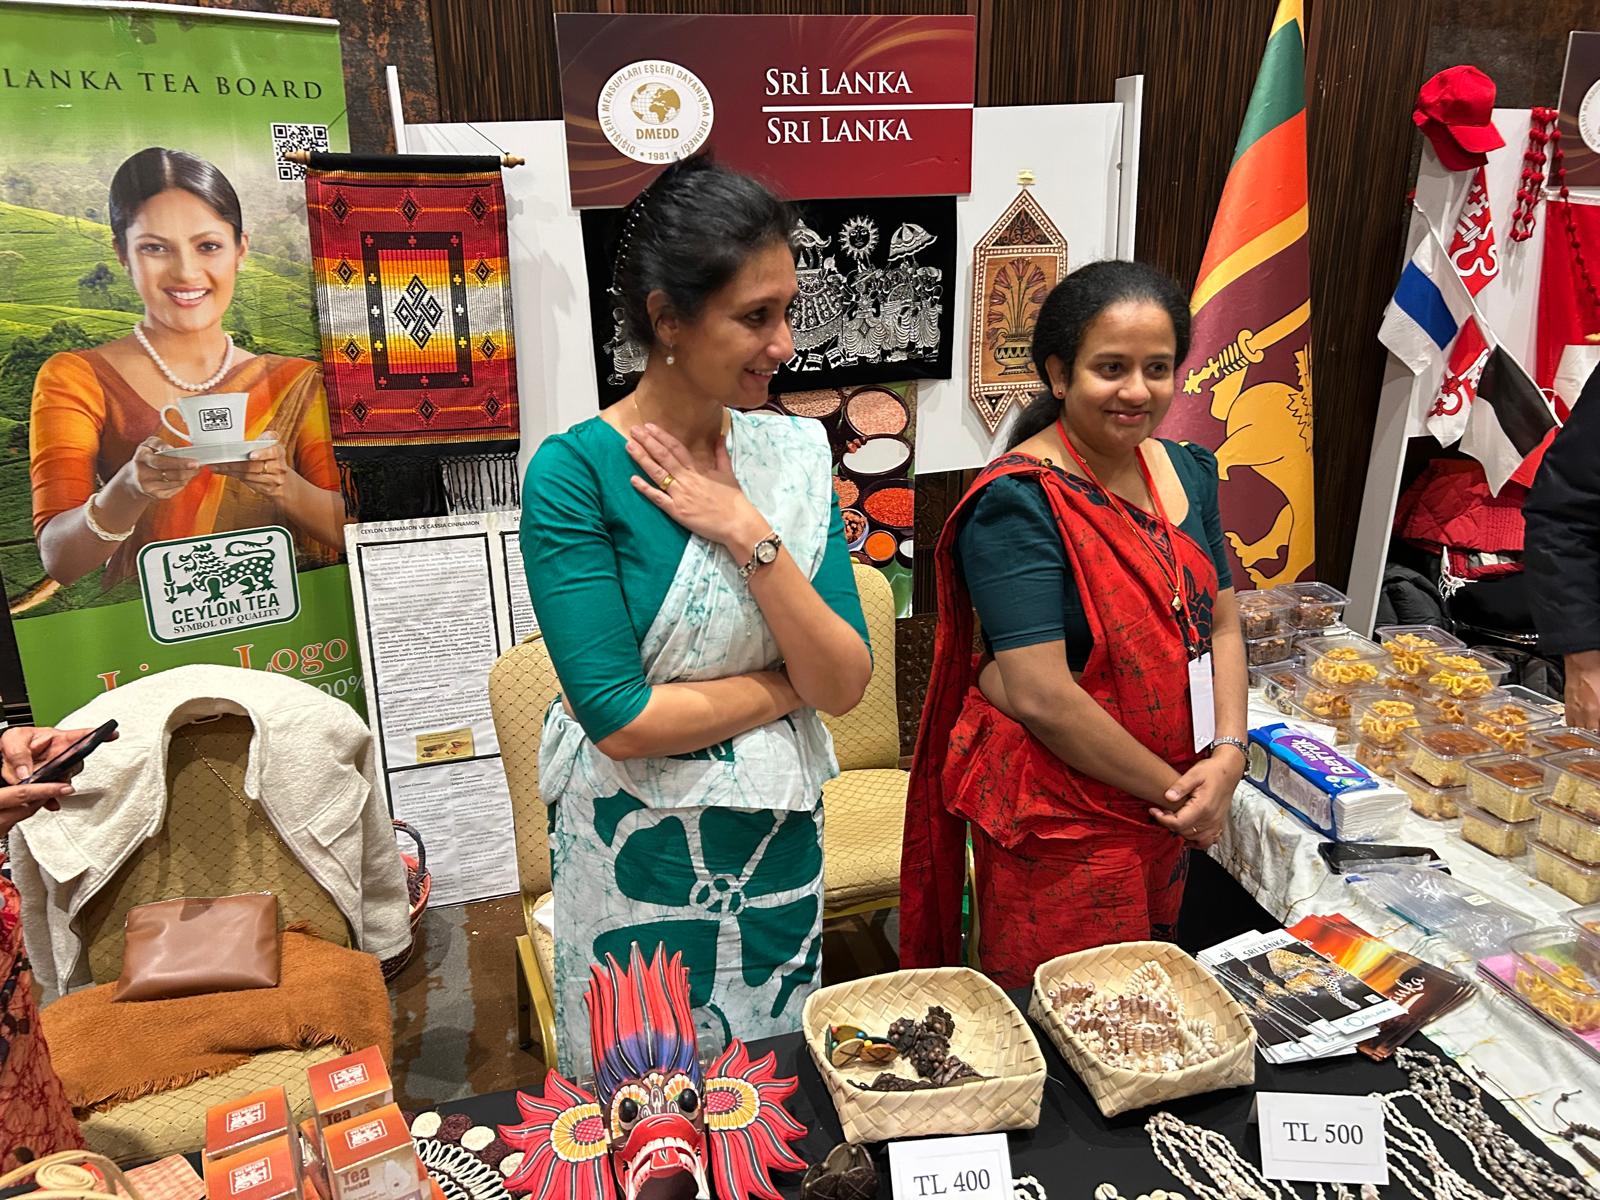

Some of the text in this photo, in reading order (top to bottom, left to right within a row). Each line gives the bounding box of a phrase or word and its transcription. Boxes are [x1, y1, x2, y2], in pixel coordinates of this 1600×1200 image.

[2, 68, 322, 99] LANKA TEA BOARD
[765, 67, 913, 96] SRİ LANKA
[636, 128, 680, 140] DMEDD
[767, 116, 913, 144] SRI LANKA
[648, 152, 670, 161] 1981
[384, 525, 417, 533] CINNAMON
[447, 520, 480, 528] CINNAMON
[171, 593, 280, 625] CEYLON TEA
[173, 608, 281, 634] SYMBOL OF QUALITY
[233, 639, 348, 675] Logo
[1242, 947, 1259, 957] SRI
[1258, 938, 1288, 952] LANKA
[1388, 975, 1425, 1004] anka
[324, 1109, 352, 1126] Tea
[1283, 1121, 1365, 1145] TL 500
[341, 1167, 370, 1186] Tea
[913, 1168, 992, 1197] TL 400
